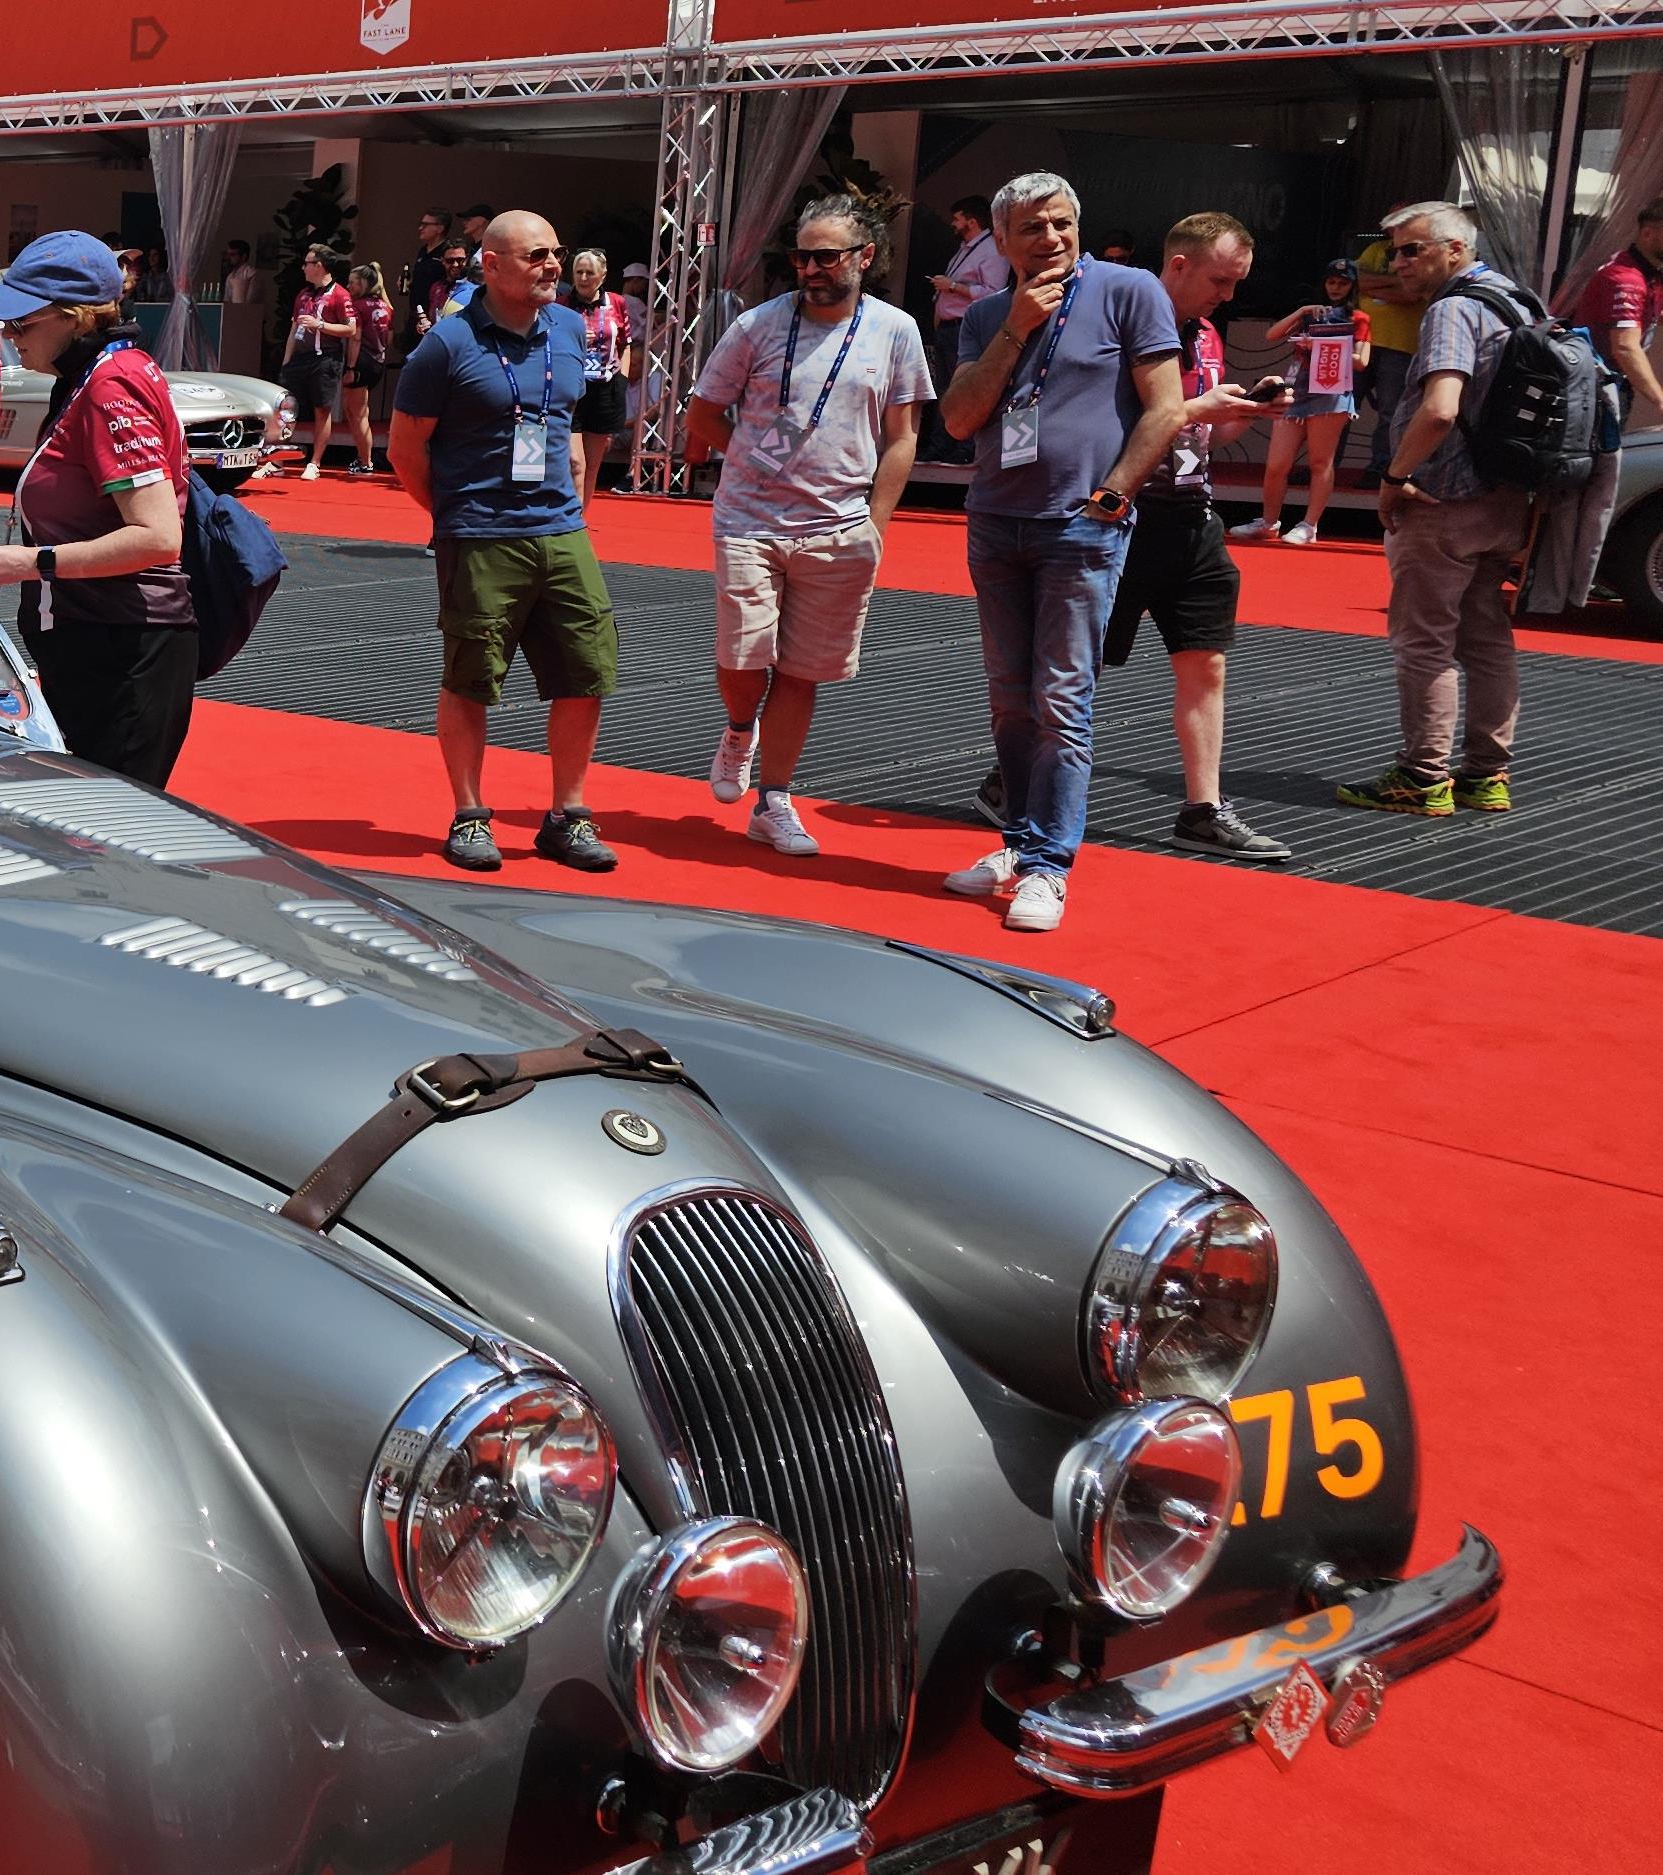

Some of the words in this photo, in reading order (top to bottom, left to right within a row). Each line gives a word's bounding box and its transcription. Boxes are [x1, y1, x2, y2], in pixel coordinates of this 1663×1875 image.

[384, 26, 406, 35] LANE
[1318, 344, 1329, 379] MIGLIA
[1329, 348, 1339, 377] 1000
[108, 416, 131, 434] pib
[1229, 1376, 1384, 1527] 75
